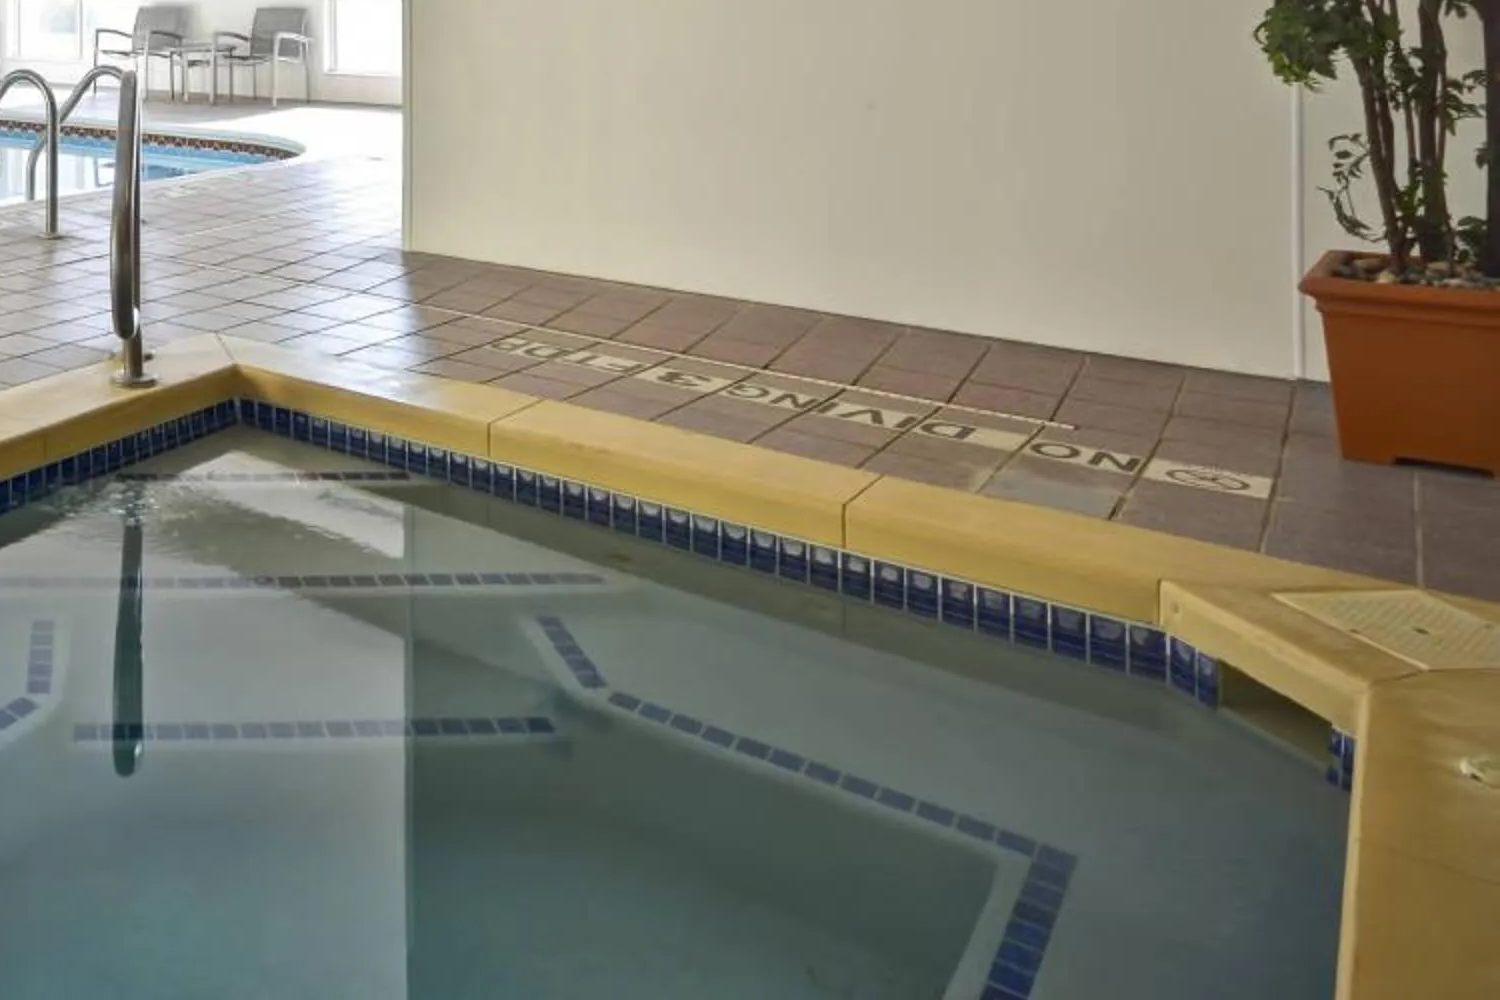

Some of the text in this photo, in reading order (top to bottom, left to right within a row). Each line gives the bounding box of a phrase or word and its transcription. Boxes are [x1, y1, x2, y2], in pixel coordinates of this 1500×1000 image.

[656, 369, 712, 388] 3
[727, 383, 977, 440] DIVING
[1029, 441, 1141, 472] NO
